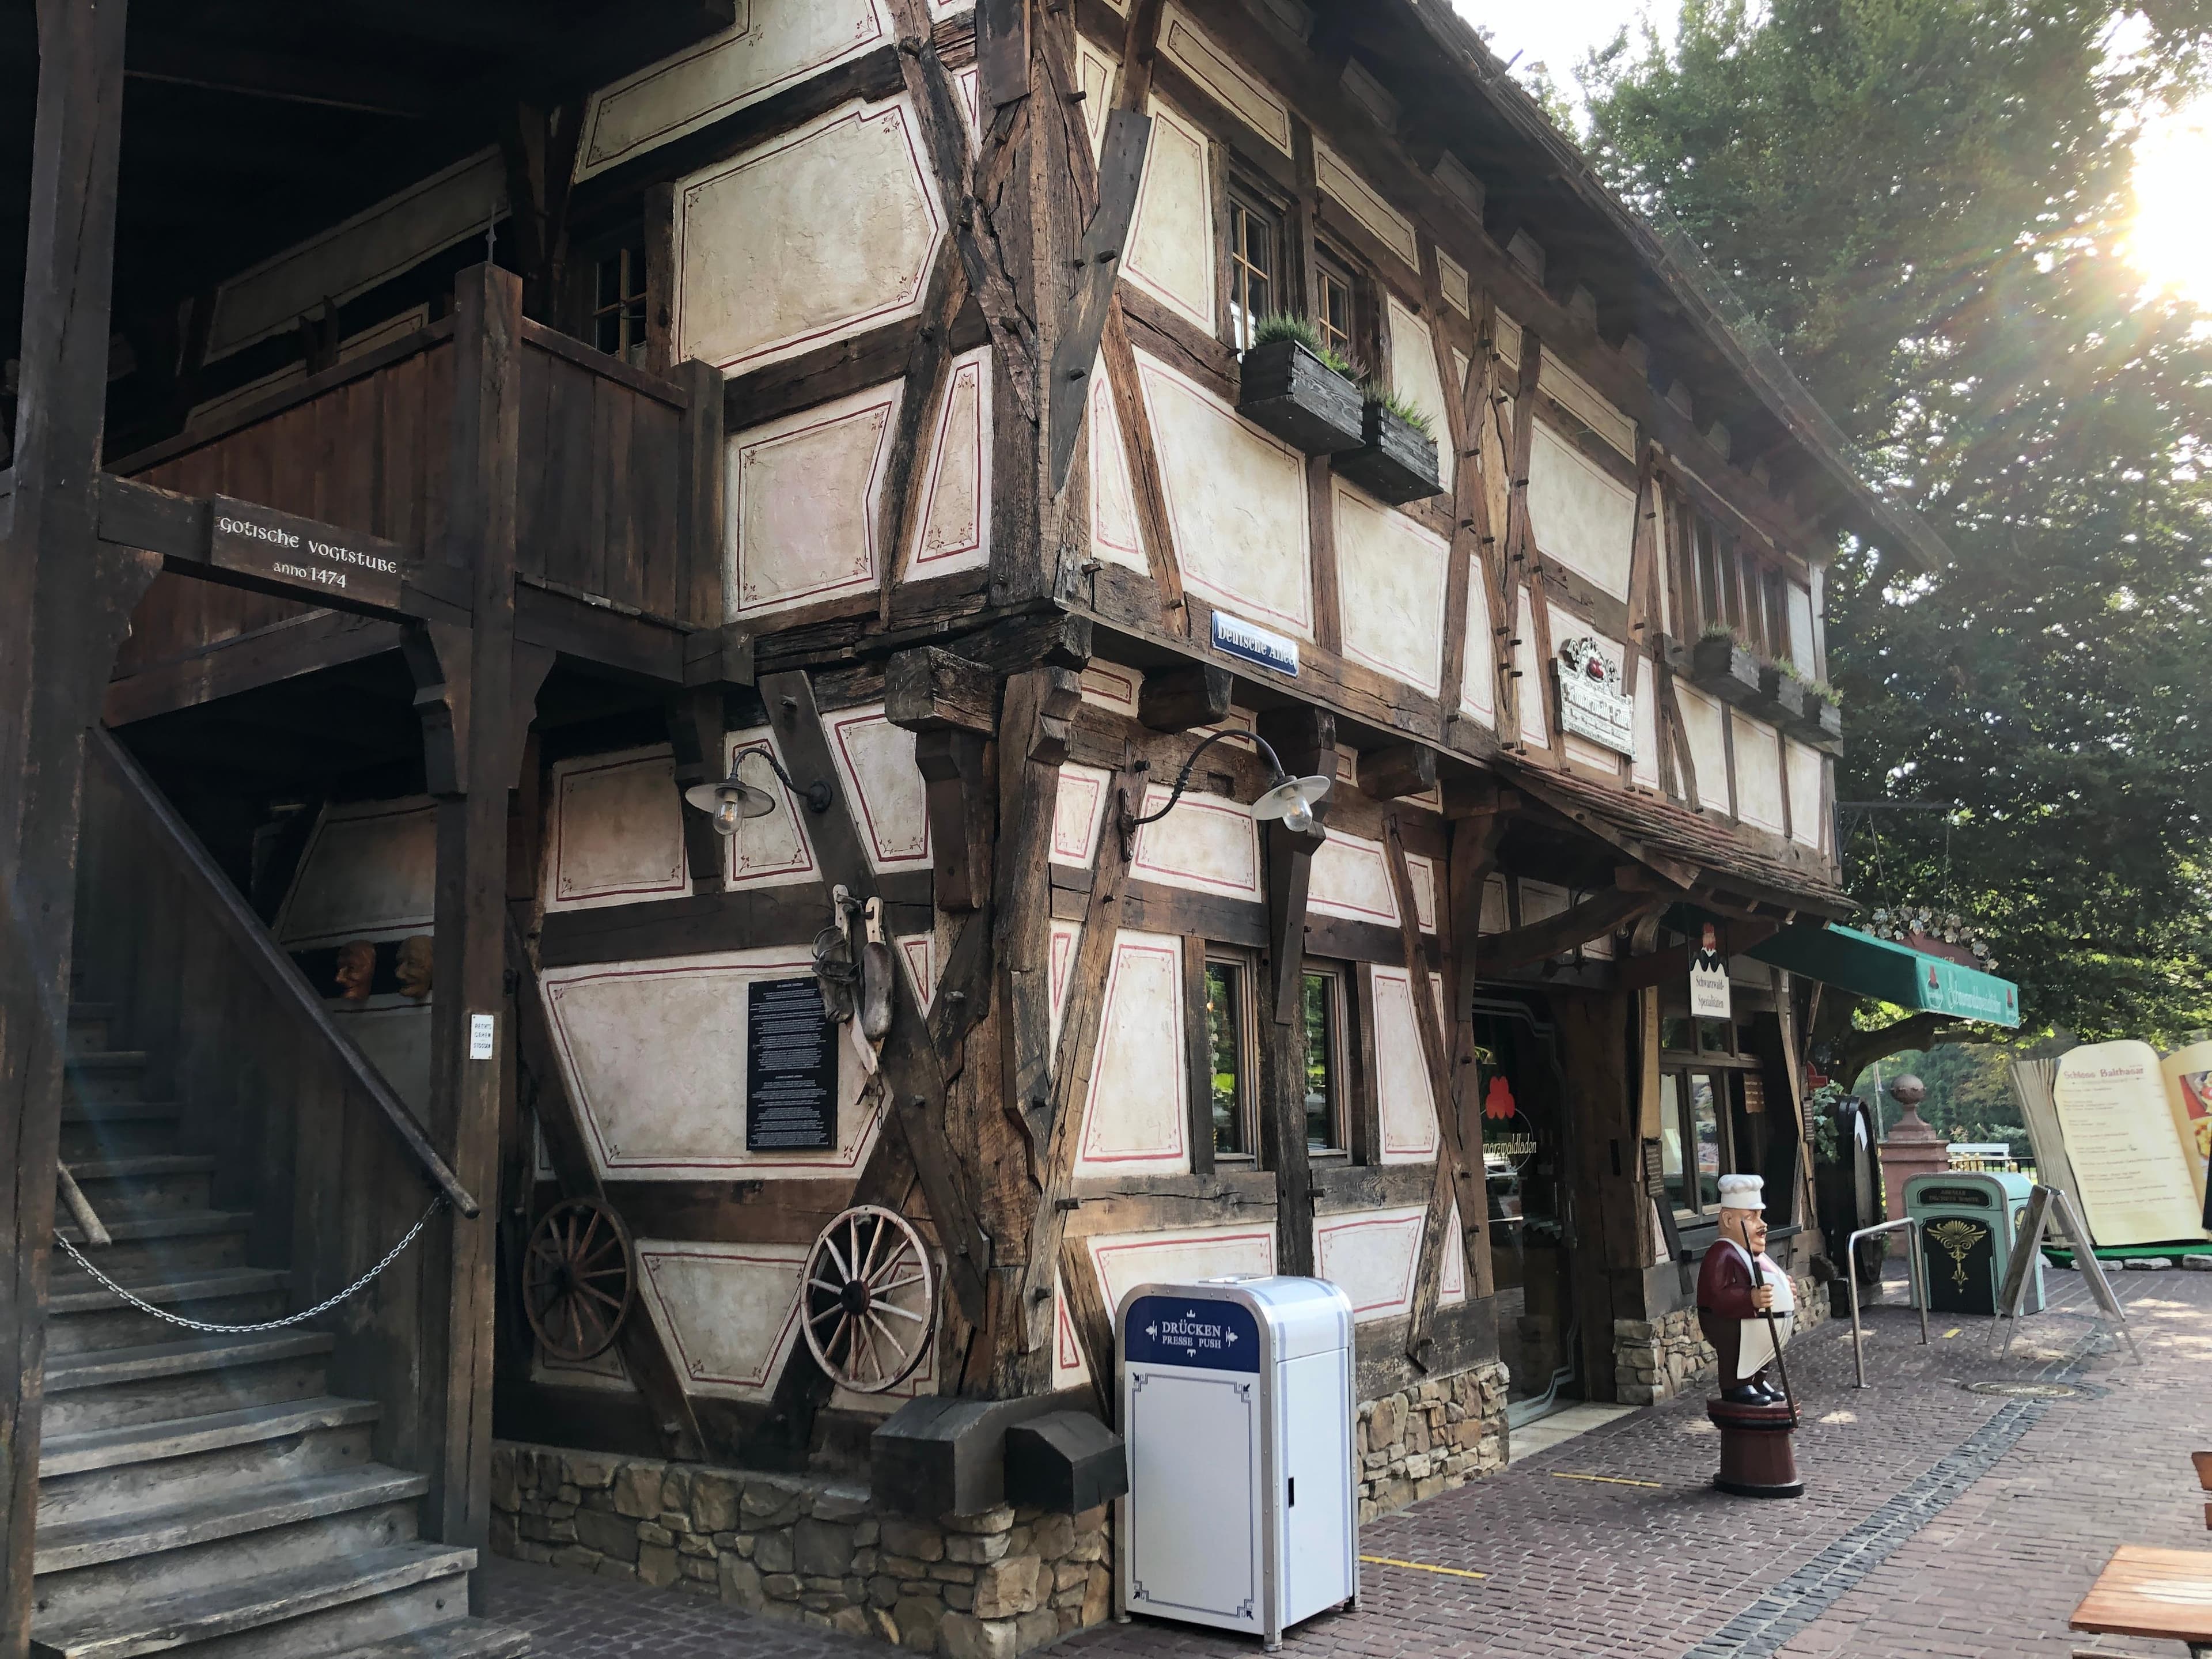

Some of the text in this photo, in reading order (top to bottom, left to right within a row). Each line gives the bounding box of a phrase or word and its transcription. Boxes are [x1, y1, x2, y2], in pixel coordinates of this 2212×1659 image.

[274, 562, 346, 588] anno 1474
[1218, 622, 1267, 656] Deutsche
[1483, 1132, 1537, 1155] warzwaldladen
[1162, 1319, 1221, 1337] DRÜCKEN
[1162, 1335, 1222, 1349] PRESSE PUSH
